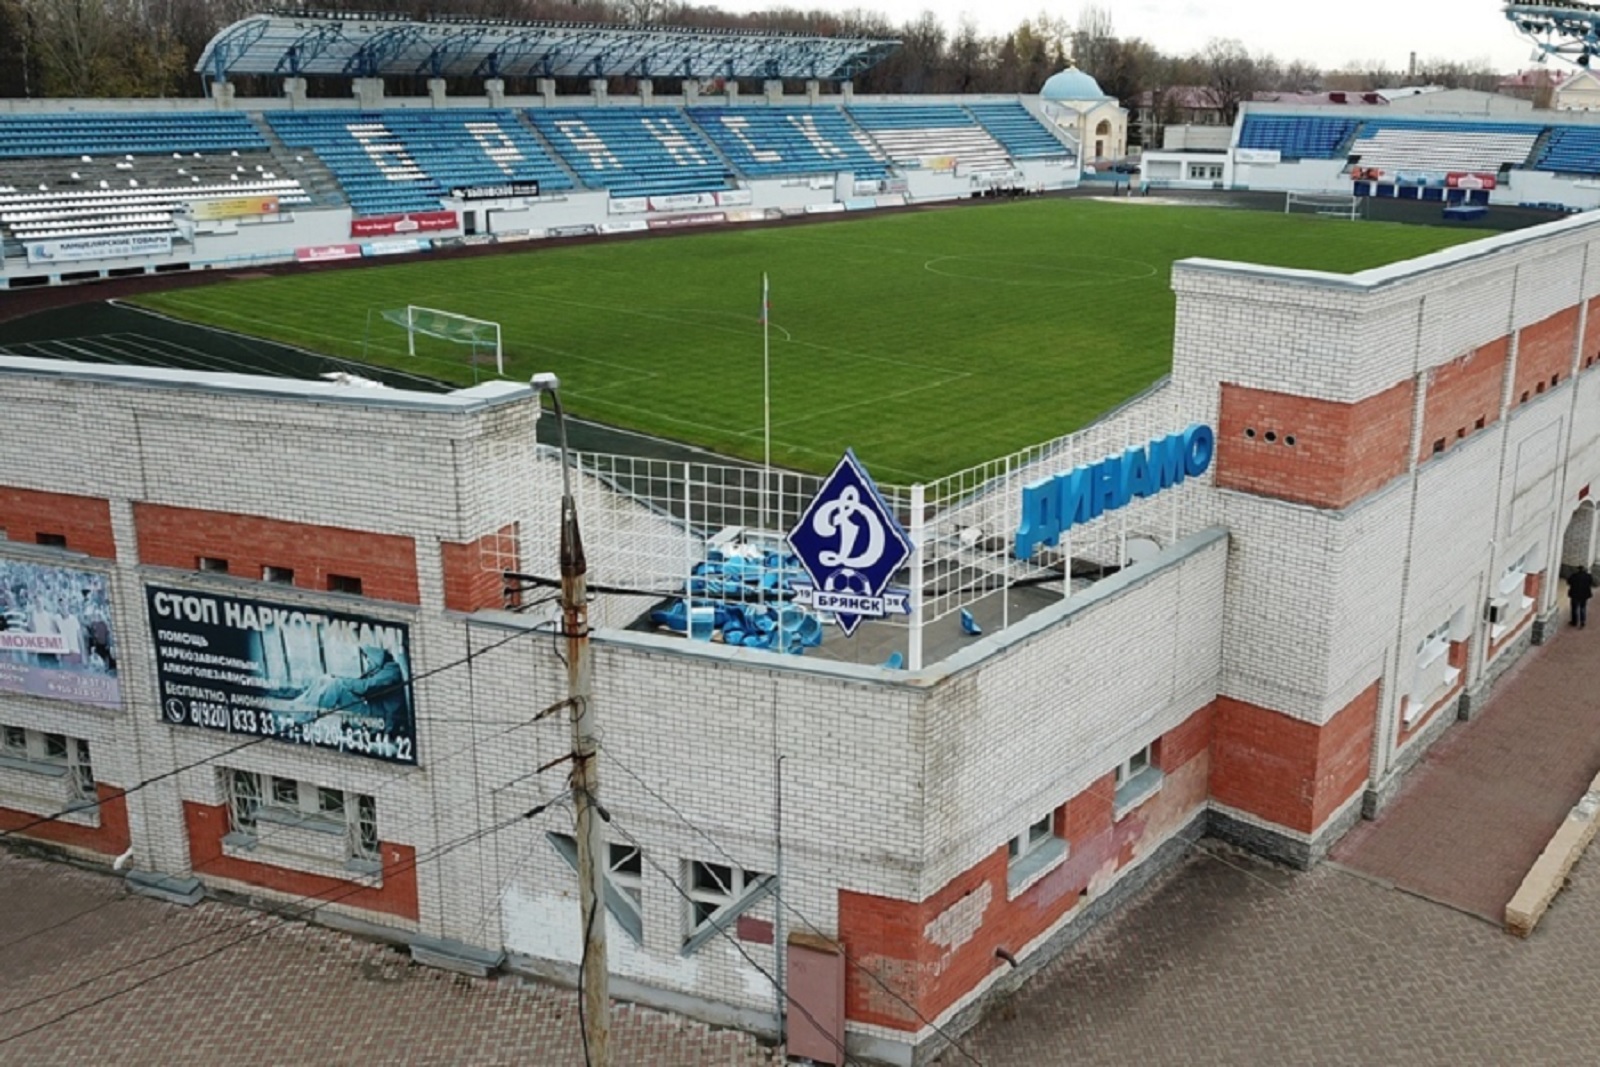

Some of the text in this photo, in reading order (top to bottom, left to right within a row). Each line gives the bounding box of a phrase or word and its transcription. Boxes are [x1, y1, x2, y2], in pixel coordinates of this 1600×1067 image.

[1014, 424, 1214, 560] ДИНАМО
[818, 595, 880, 611] БРЯНСК
[0, 634, 63, 649] МОЖЕМ!
[154, 591, 403, 654] СТОП НАРКОТИКАМ!
[158, 629, 209, 647] ПОМОЩЬ
[190, 701, 231, 733] 8(920)
[232, 708, 257, 732] 833
[260, 711, 276, 735] 33
[396, 736, 413, 760] 22
